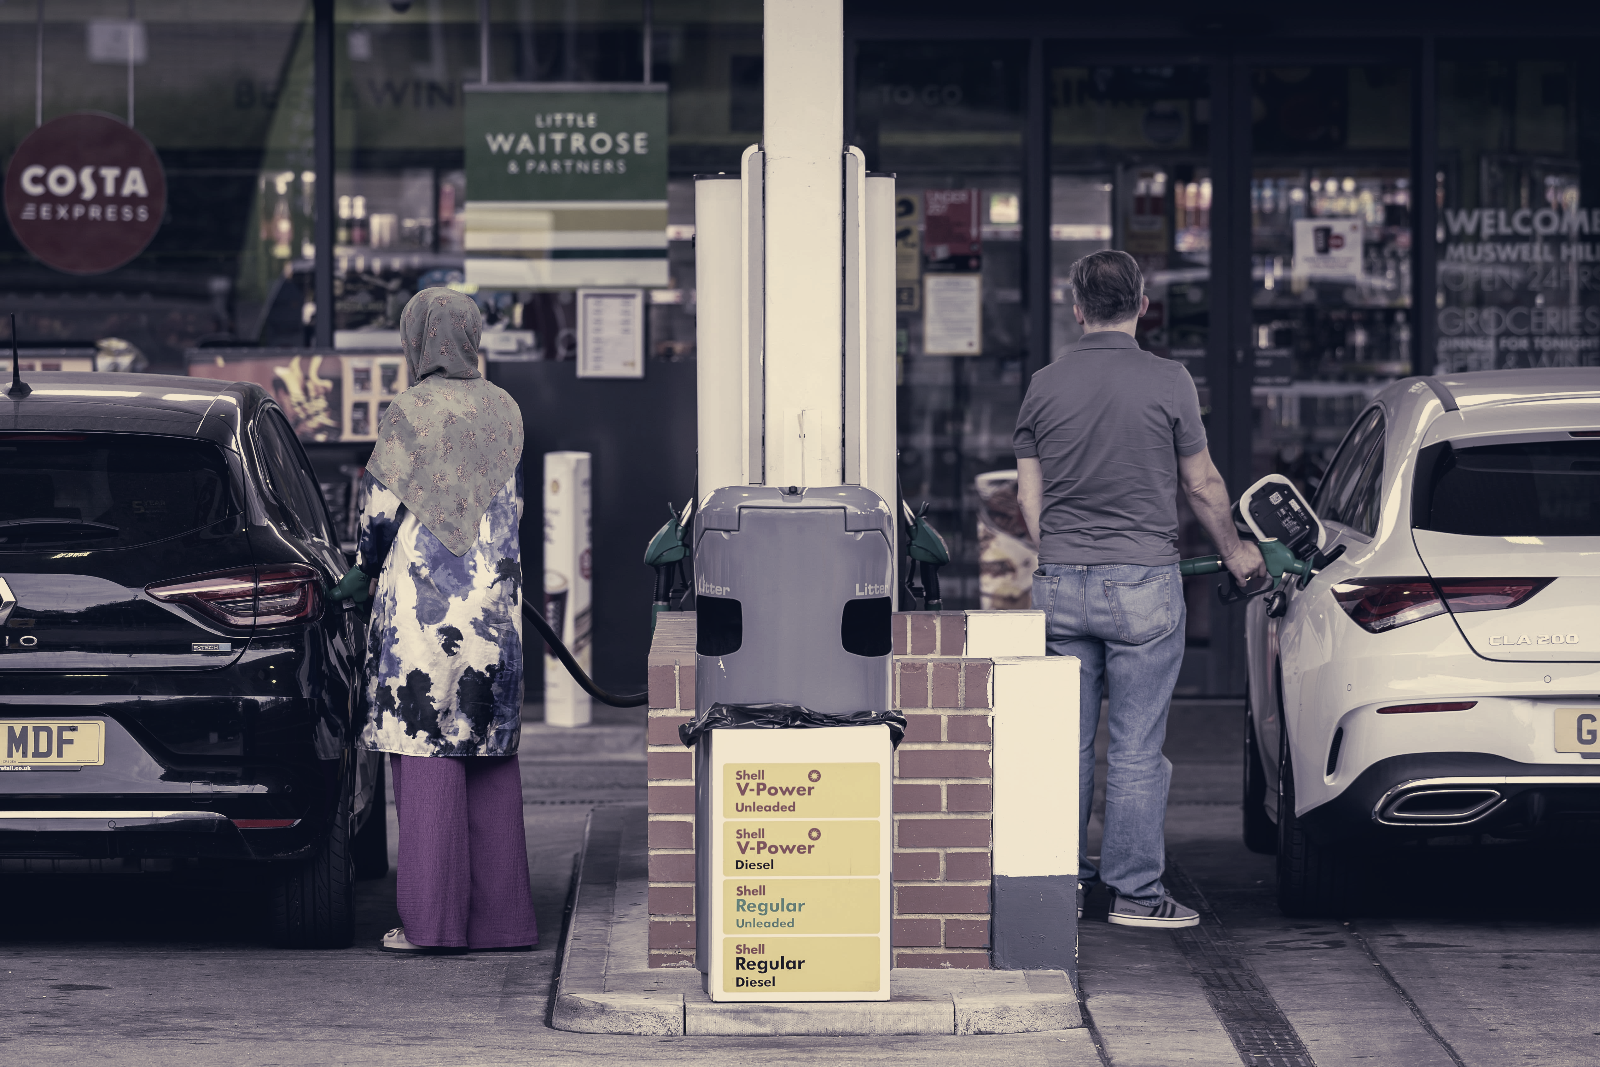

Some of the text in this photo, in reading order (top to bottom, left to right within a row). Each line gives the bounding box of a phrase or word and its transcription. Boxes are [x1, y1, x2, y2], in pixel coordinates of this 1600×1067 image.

[367, 79, 463, 108] WIN
[535, 113, 597, 128] LITTLE
[486, 132, 648, 155] WAITROSE
[507, 159, 627, 174] & PARTNERS
[21, 165, 148, 200] COSTA
[40, 204, 149, 222] EXPRESS
[1444, 208, 1600, 236] WELCOME
[1446, 242, 1553, 262] MUSWELL
[1443, 267, 1518, 292] OPEN
[1437, 306, 1600, 336] GROCERIES
[1499, 336, 1529, 351] FOR
[1534, 336, 1600, 351] TONIGHT
[855, 582, 889, 597] Litter
[1488, 633, 1580, 647] CLA 200
[1576, 713, 1598, 746] G
[7, 725, 78, 758] MDF
[736, 769, 764, 781] Shell
[736, 782, 815, 797] V-Power
[736, 801, 796, 813] Unleaded
[736, 827, 765, 840] Shell
[736, 840, 816, 855] V-Power
[736, 858, 774, 870] Diesel
[736, 884, 765, 897] Shell
[736, 897, 806, 916] Regular
[736, 917, 796, 929] Unleaded
[736, 943, 765, 955] Shell
[736, 955, 806, 974] Regular
[736, 975, 776, 988] Diesel
